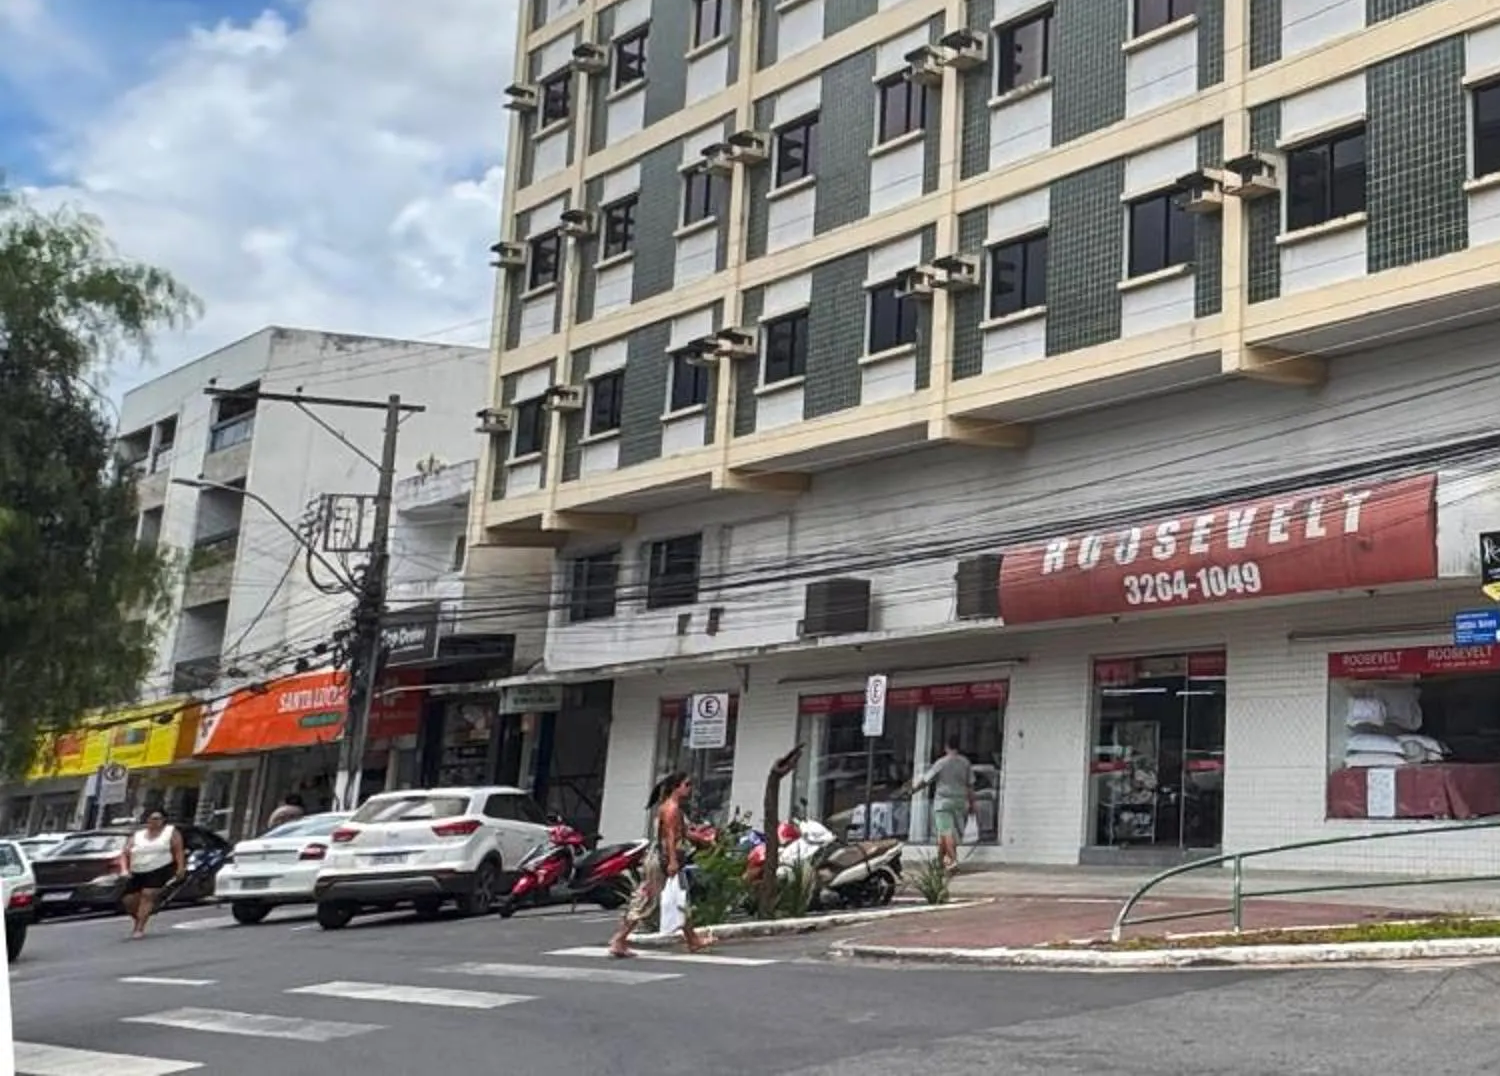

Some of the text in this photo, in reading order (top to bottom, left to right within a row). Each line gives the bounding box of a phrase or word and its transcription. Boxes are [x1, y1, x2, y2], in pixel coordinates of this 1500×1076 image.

[1041, 490, 1371, 575] ROOSEVELT
[1123, 562, 1263, 605] 3264-1049
[705, 699, 716, 714] E
